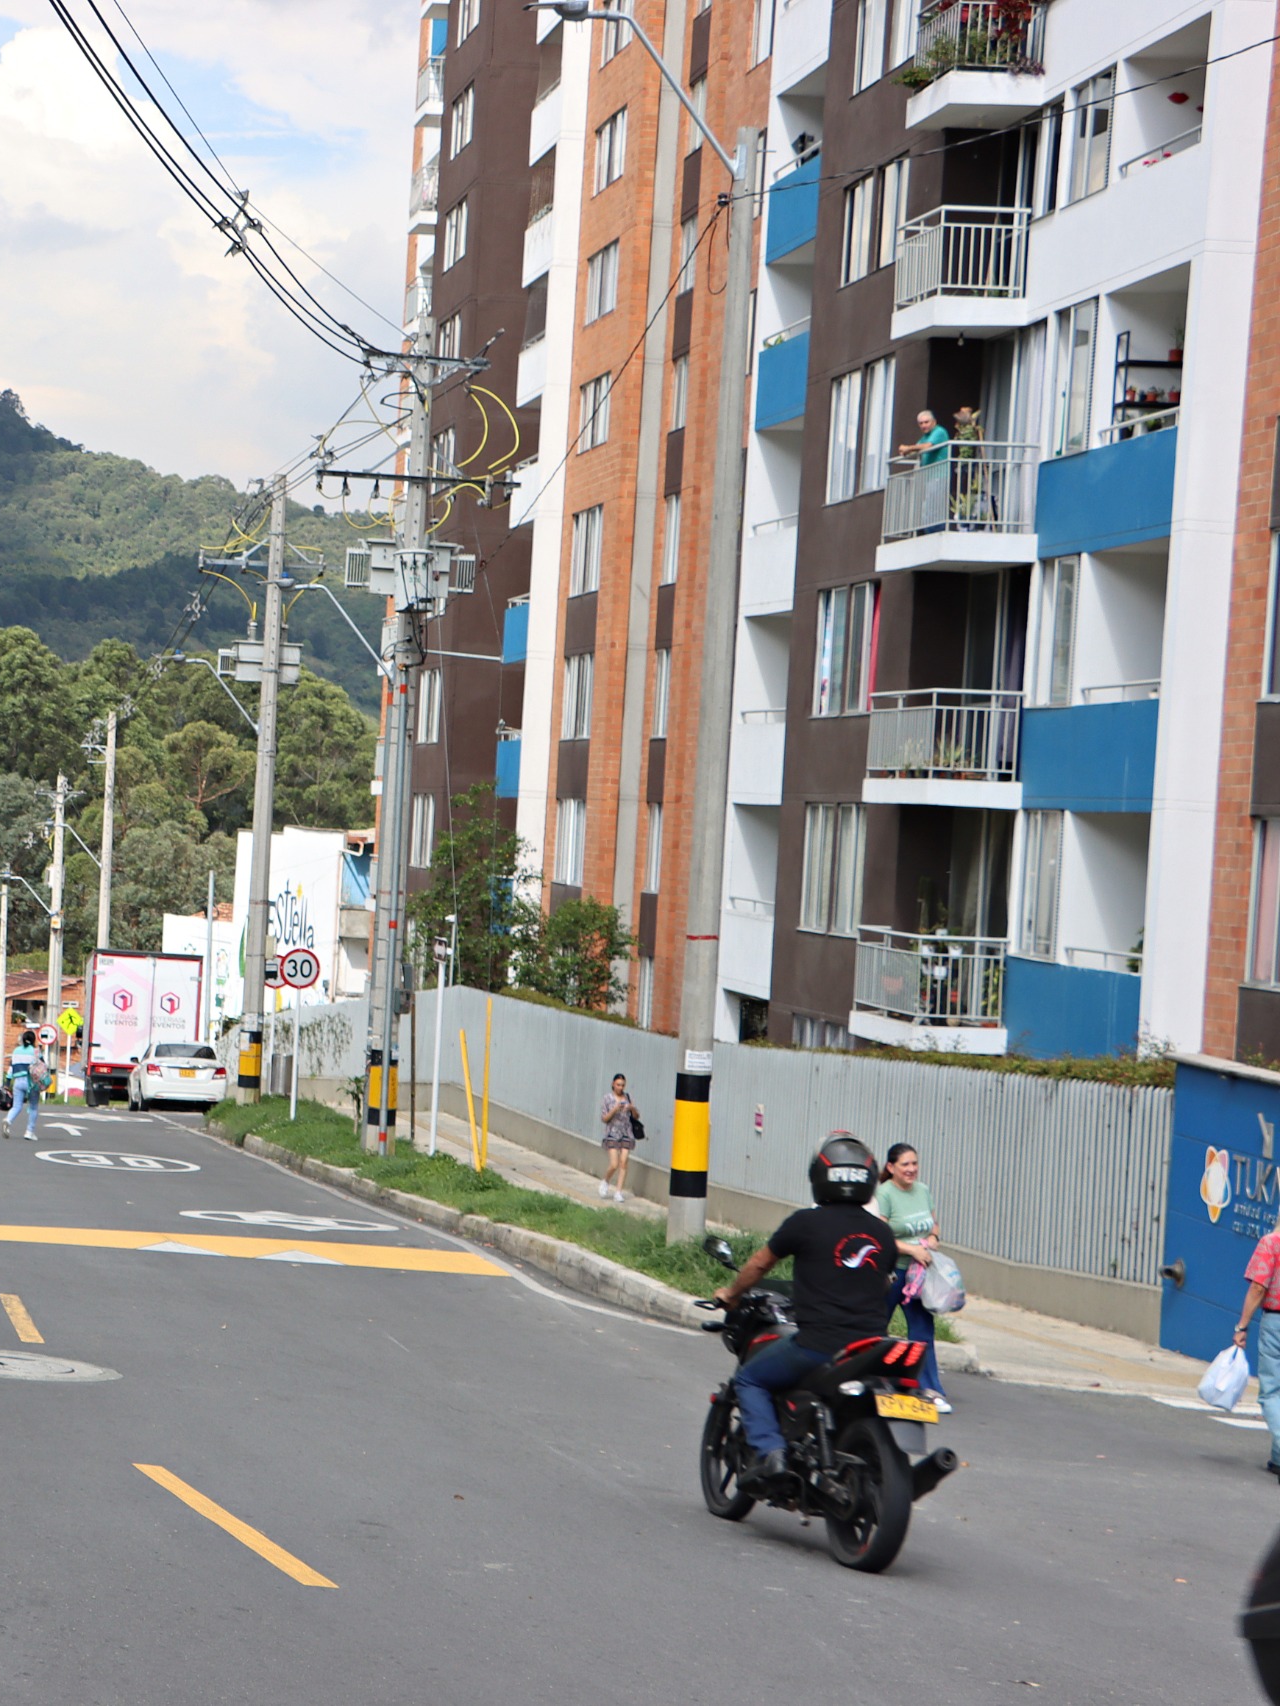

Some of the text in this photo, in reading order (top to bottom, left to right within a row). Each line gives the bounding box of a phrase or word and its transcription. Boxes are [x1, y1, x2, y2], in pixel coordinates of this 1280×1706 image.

[287, 959, 313, 978] 30
[104, 1019, 138, 1027] EVENTOS
[152, 1022, 186, 1030] EVENTOS
[70, 1153, 165, 1168] 30
